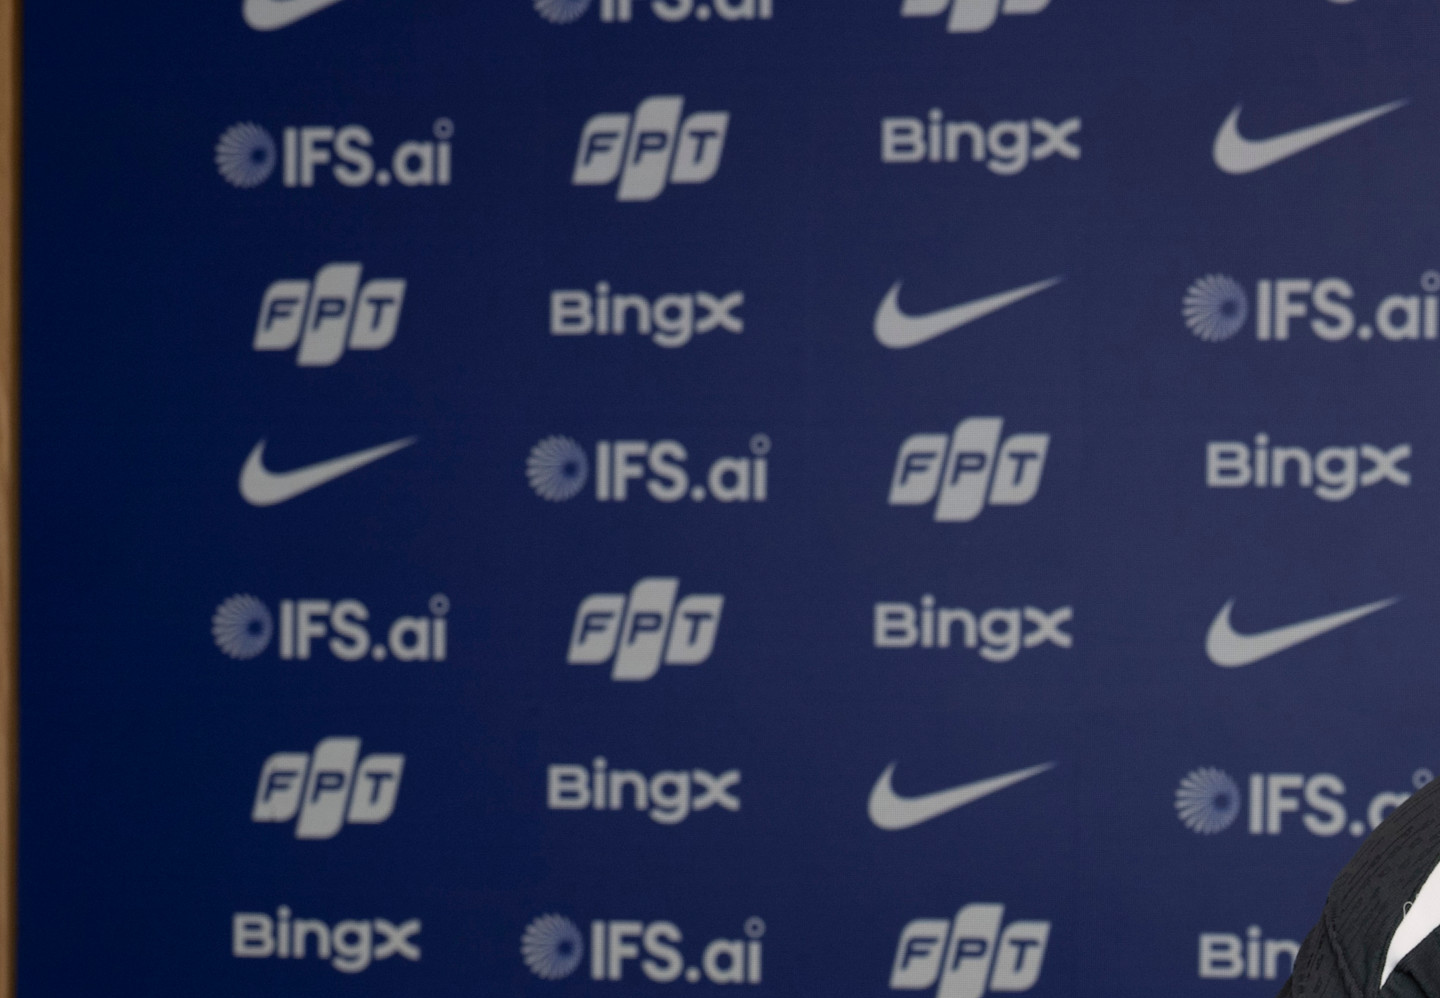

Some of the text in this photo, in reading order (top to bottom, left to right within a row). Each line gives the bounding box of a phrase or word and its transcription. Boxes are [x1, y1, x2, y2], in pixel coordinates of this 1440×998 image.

[283, 119, 453, 187] IFS.ai
[1257, 271, 1440, 340] IFS.ai
[596, 435, 769, 502] IFS.ai
[280, 595, 449, 661] IFS.ai
[1249, 768, 1434, 836] IFS.
[591, 918, 764, 983] IFS.ai
[1198, 925, 1302, 979] Bin
